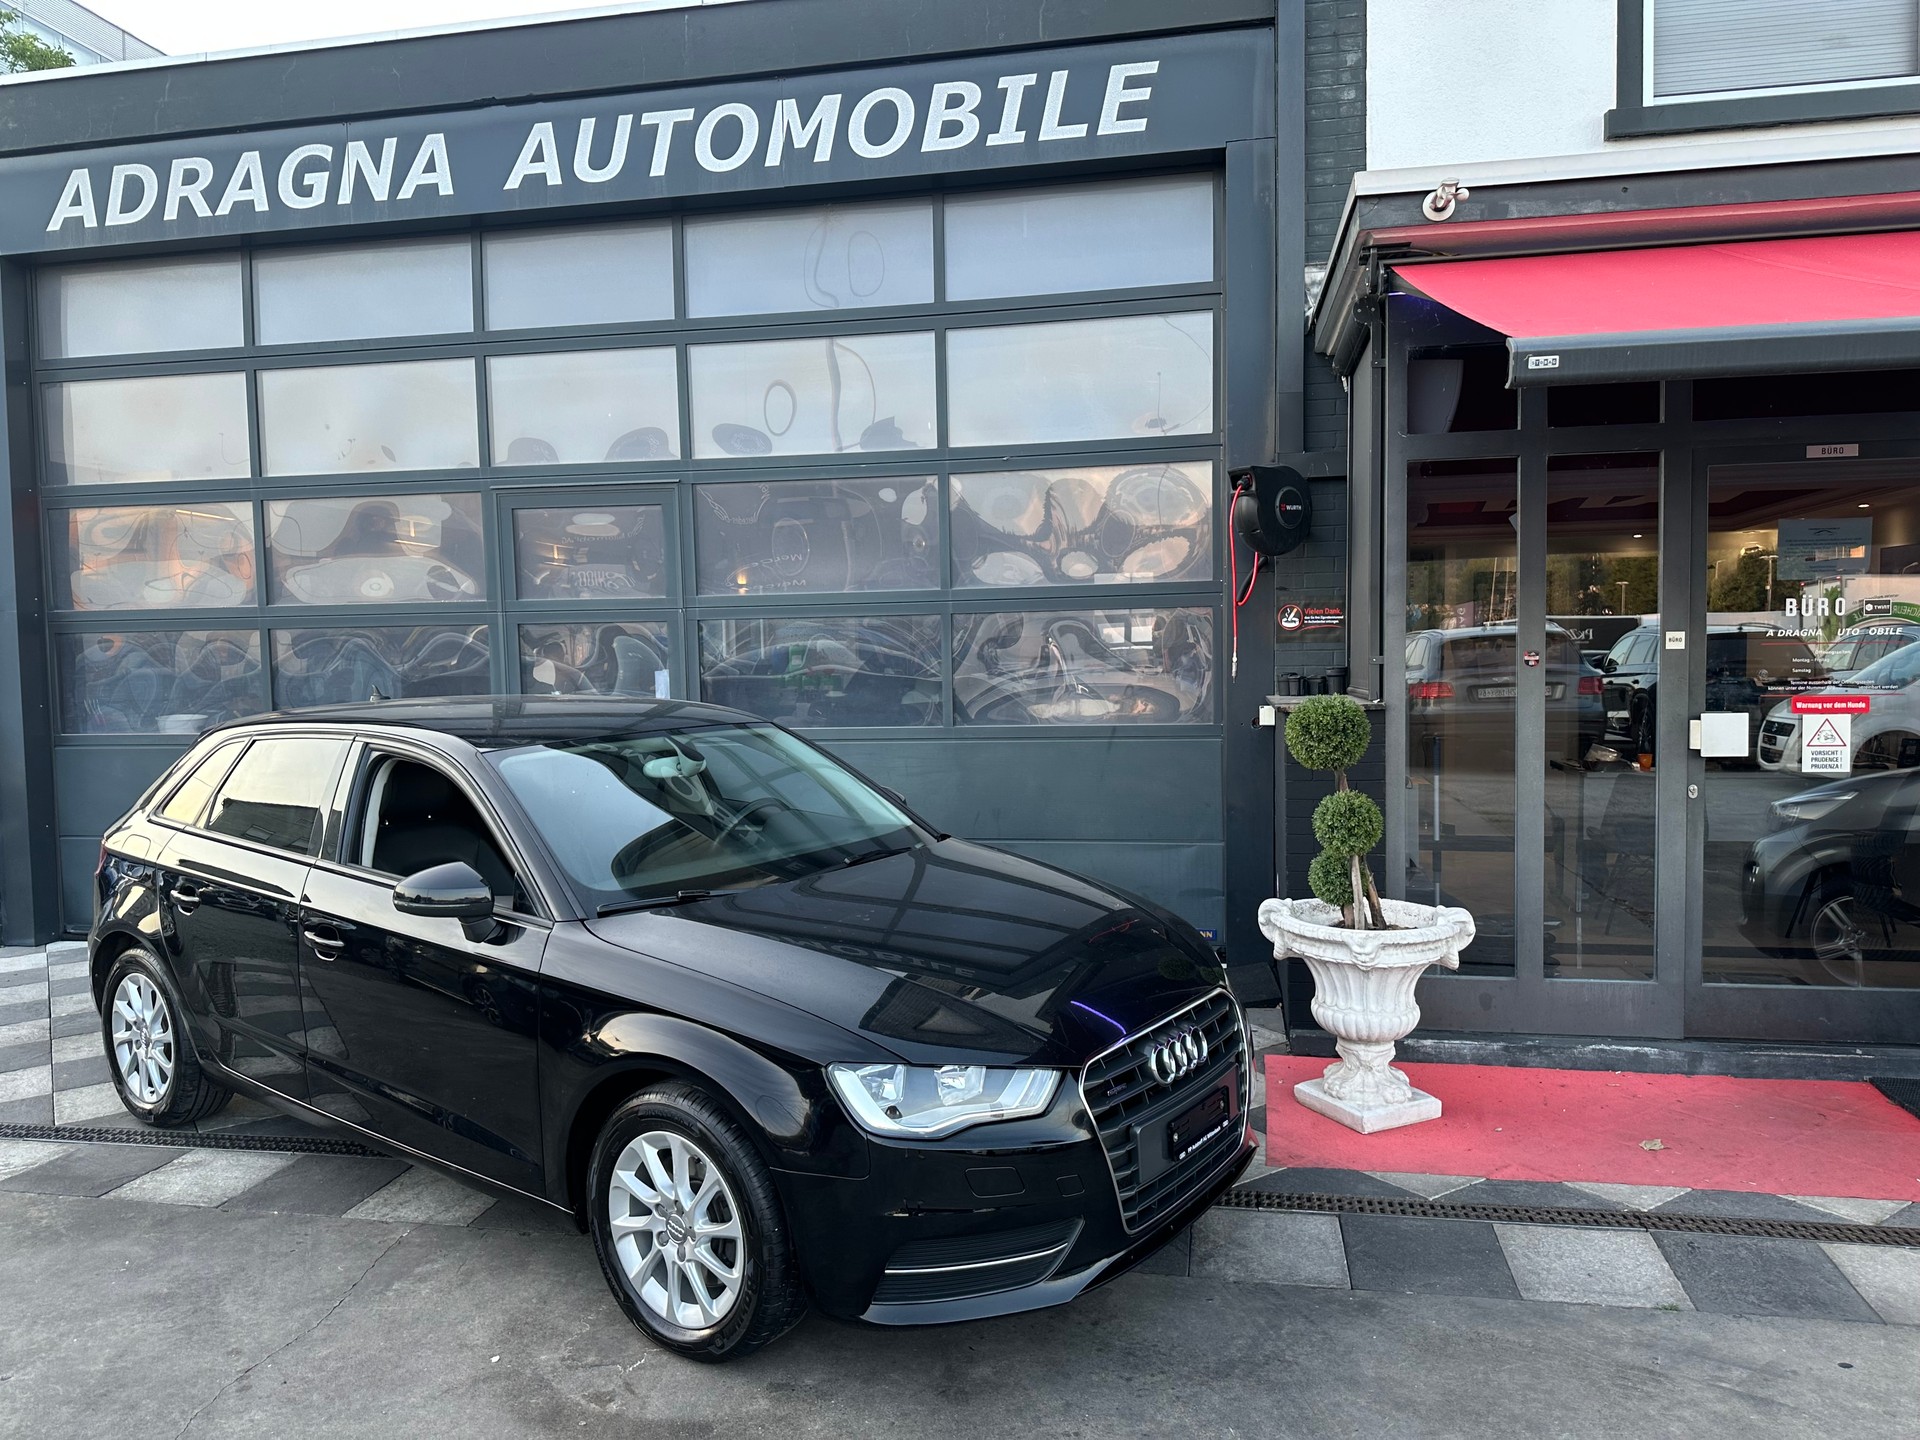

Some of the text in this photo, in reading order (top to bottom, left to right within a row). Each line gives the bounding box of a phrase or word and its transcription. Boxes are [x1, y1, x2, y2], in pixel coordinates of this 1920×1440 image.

[45, 60, 1160, 232] ADRAGNA AUTOMOBILE
[1821, 445, 1844, 455] BÜRO
[1785, 594, 1846, 617] BÜRO
[1304, 607, 1323, 615] Vielen
[1796, 701, 1822, 709] Warnung
